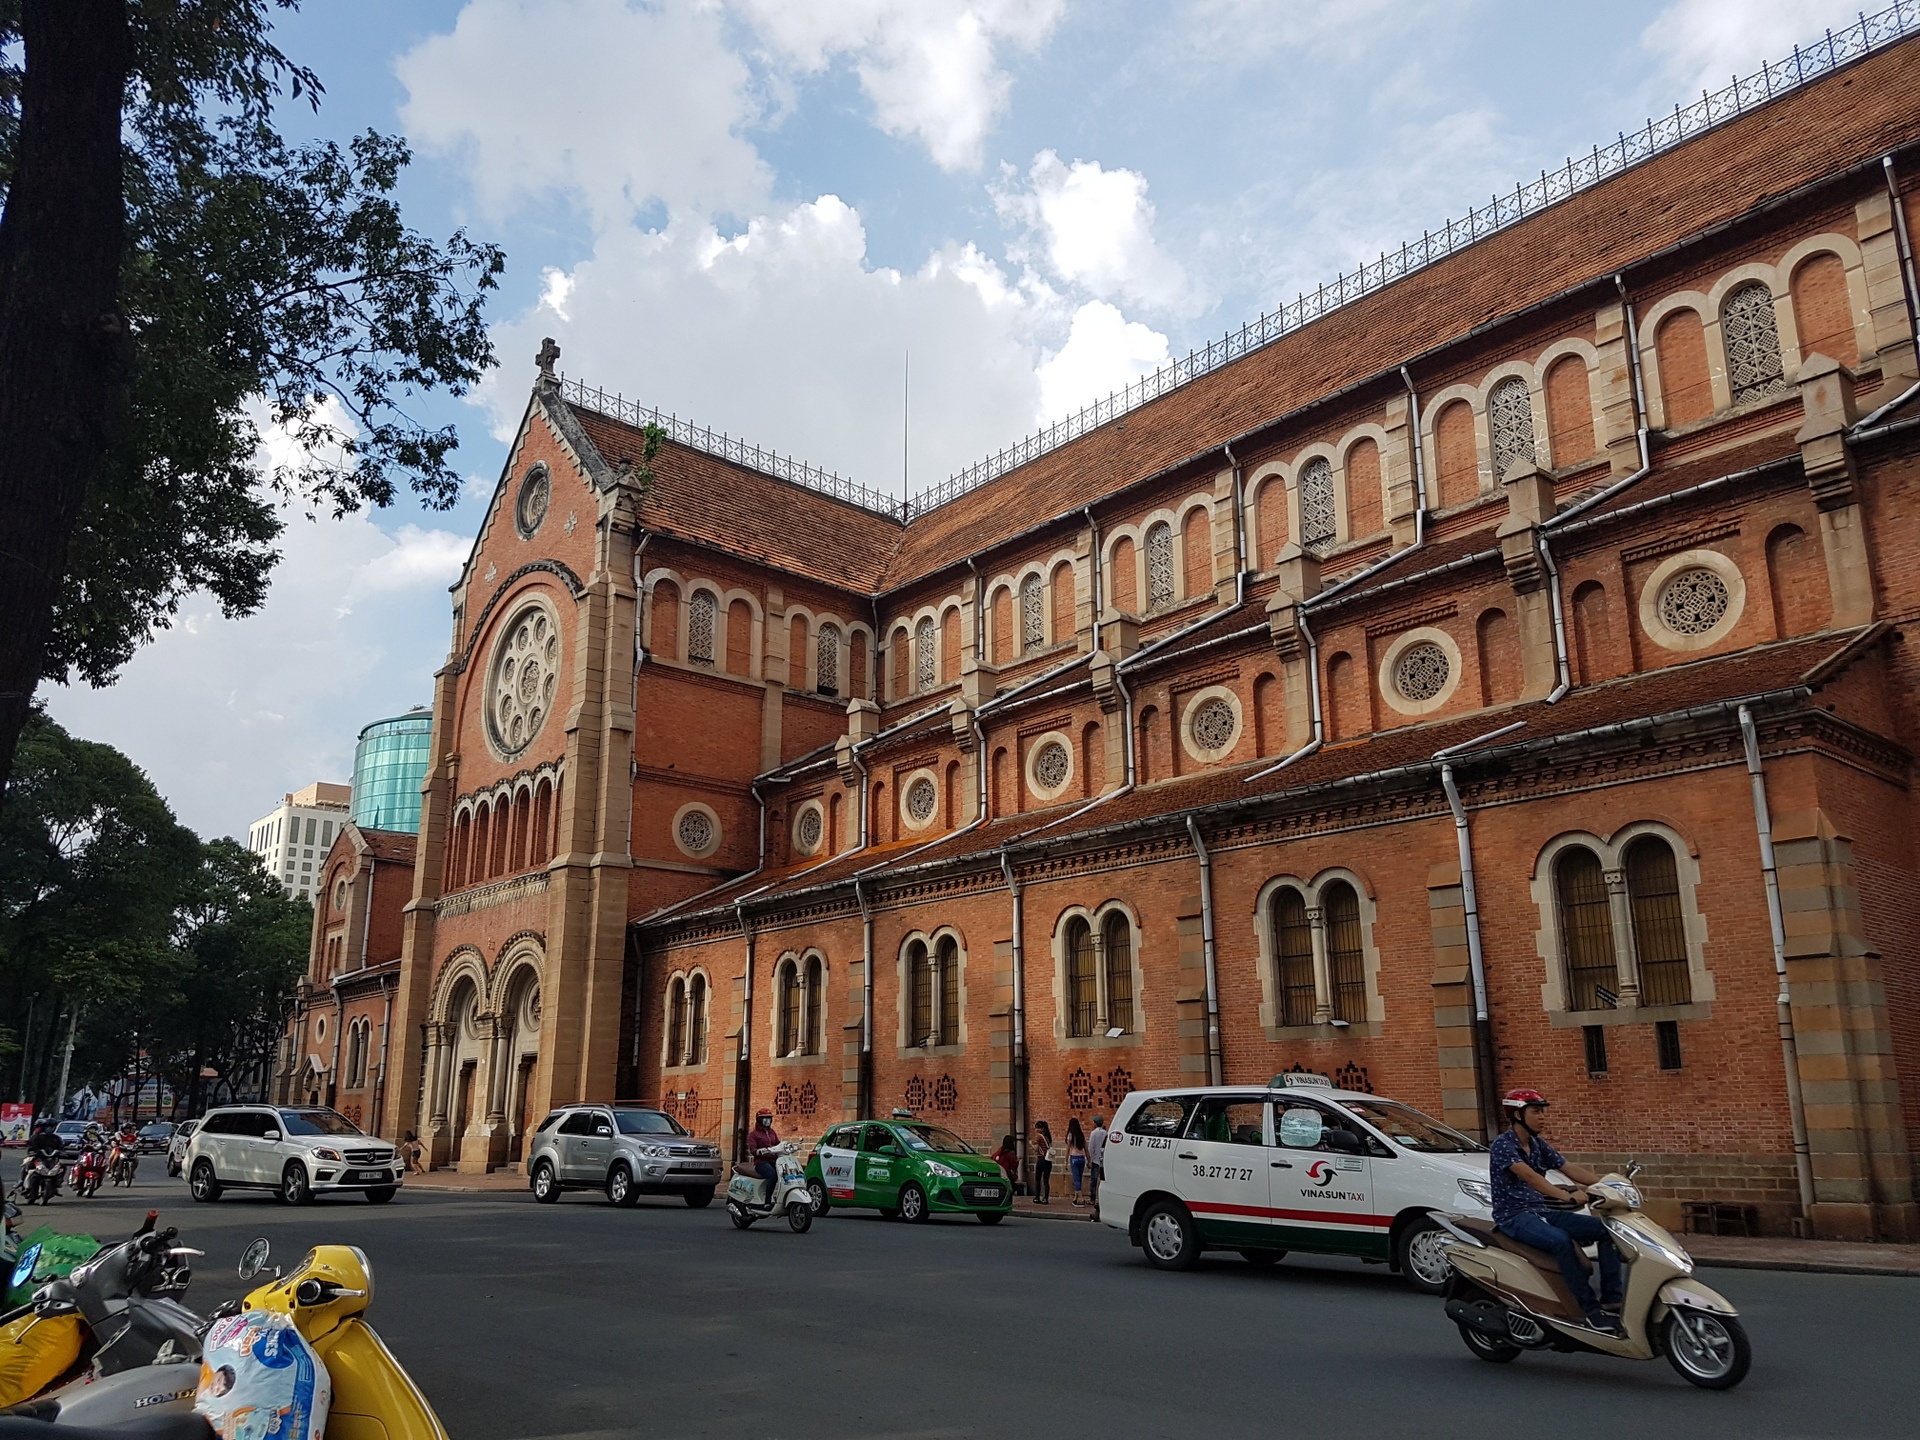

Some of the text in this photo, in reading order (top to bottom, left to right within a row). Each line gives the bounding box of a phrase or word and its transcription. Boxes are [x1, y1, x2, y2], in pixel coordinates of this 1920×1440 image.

[1129, 1136, 1172, 1150] 51F 722.31
[1192, 1165, 1253, 1181] 38.27 27 27
